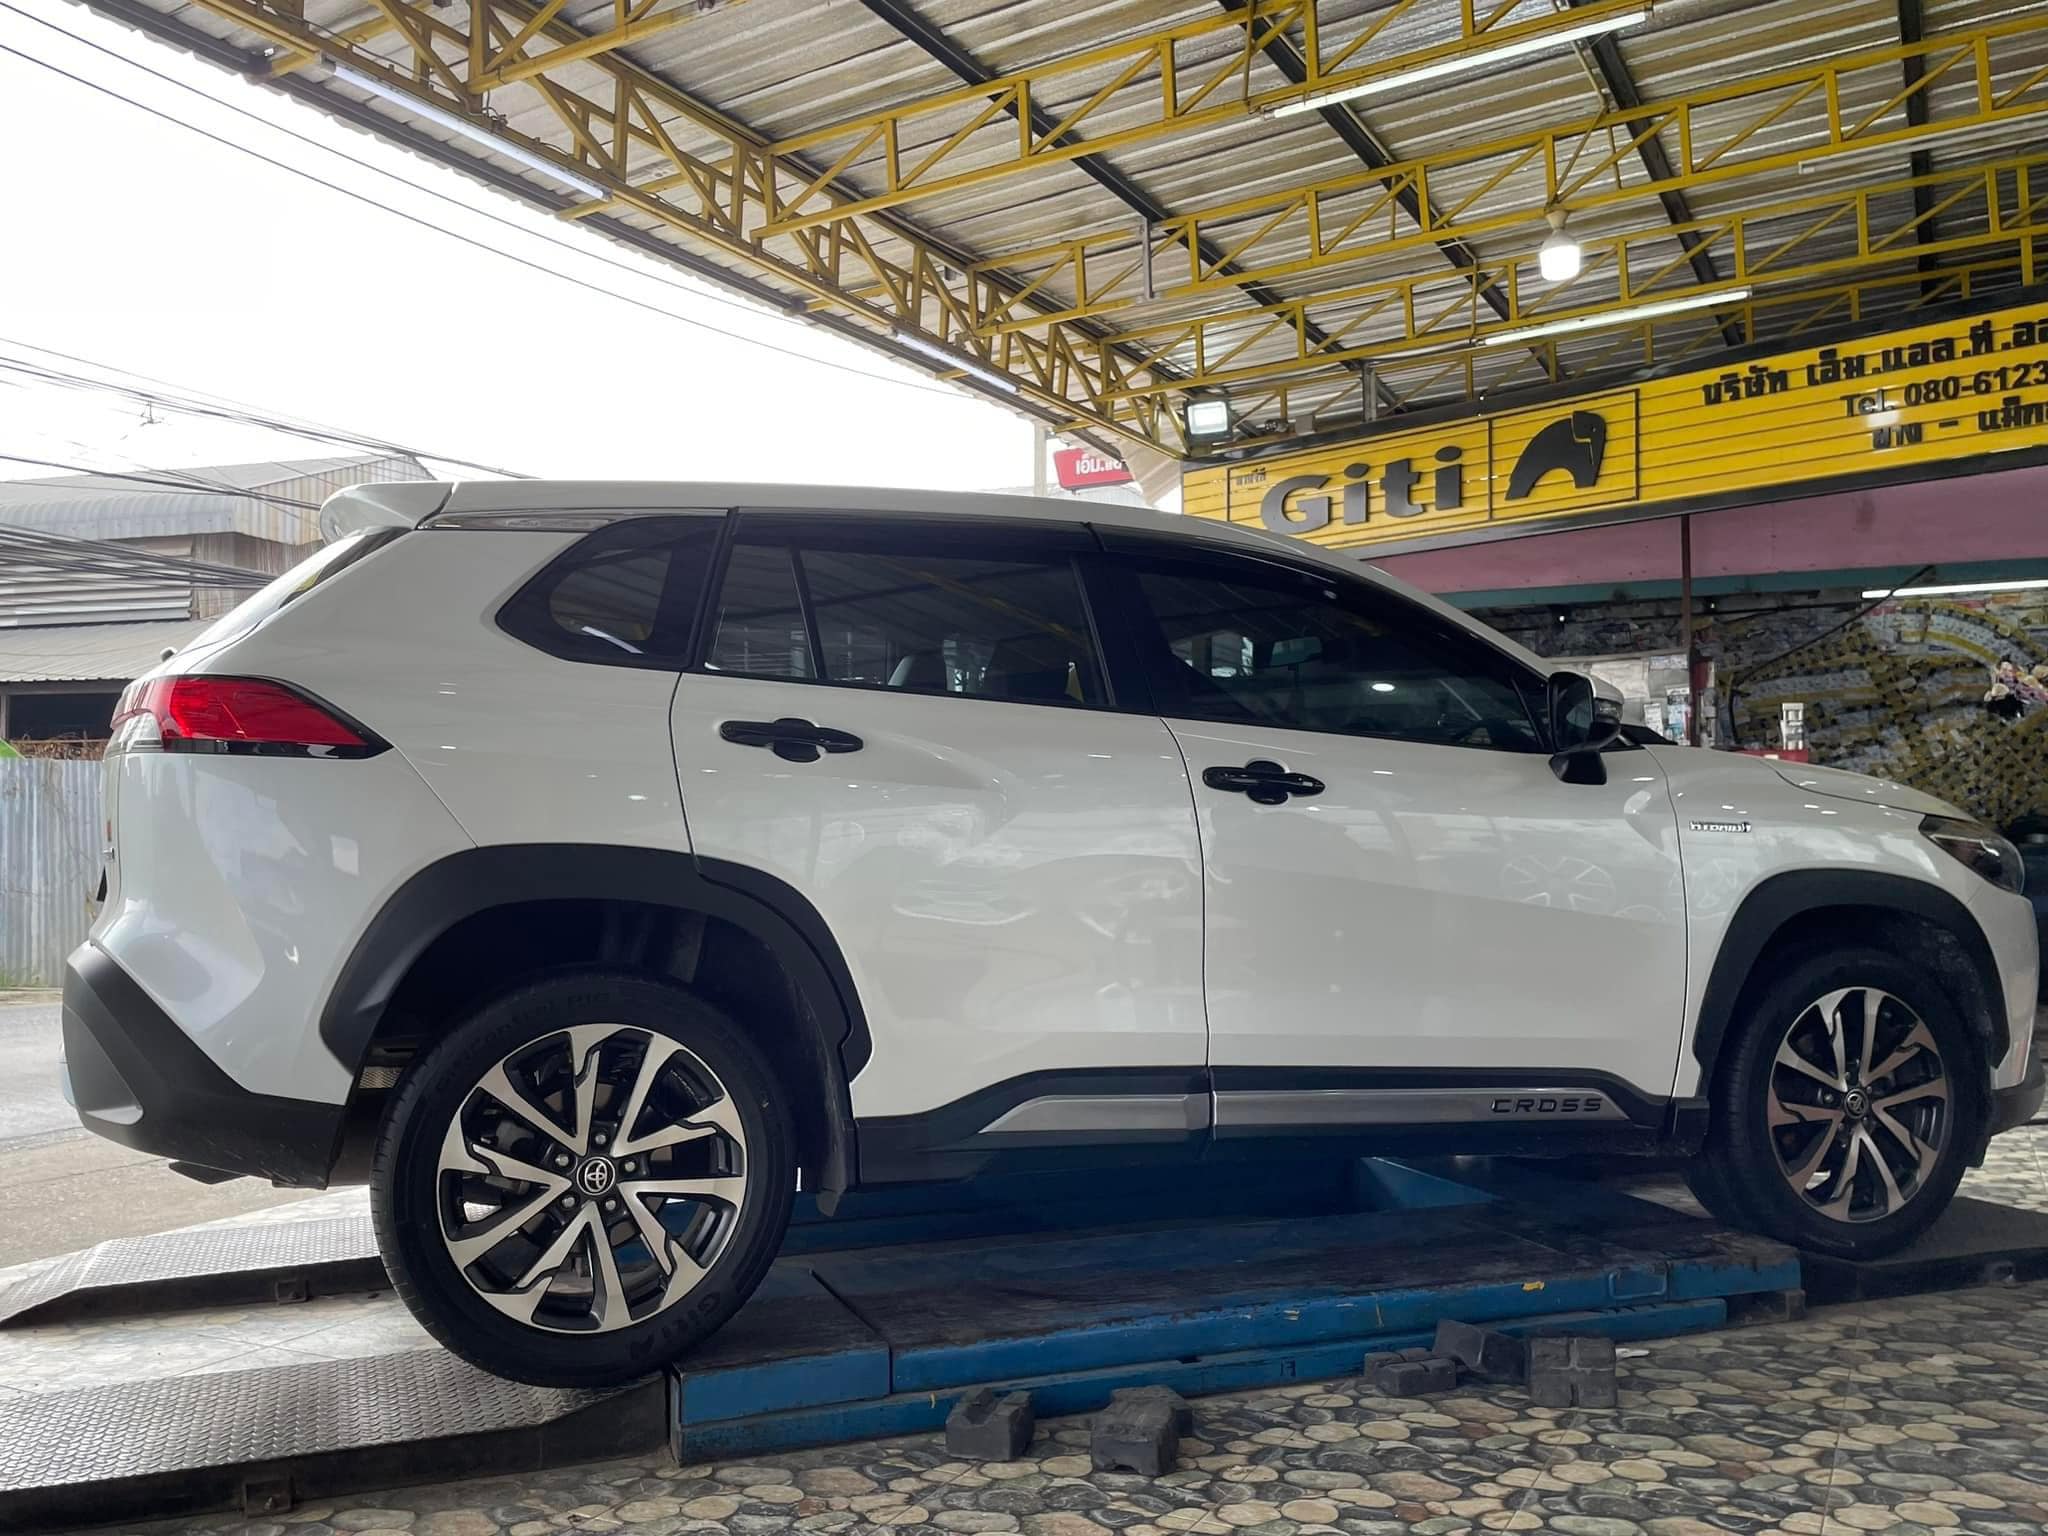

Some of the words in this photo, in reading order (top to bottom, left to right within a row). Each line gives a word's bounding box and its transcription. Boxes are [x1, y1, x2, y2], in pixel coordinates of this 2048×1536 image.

[1702, 366, 1788, 406] บริษัท
[1840, 389, 1896, 417] Tel.
[1978, 395, 2048, 432] แม็ก
[1261, 445, 1464, 535] Giti
[1491, 1097, 1602, 1113] CROSS
